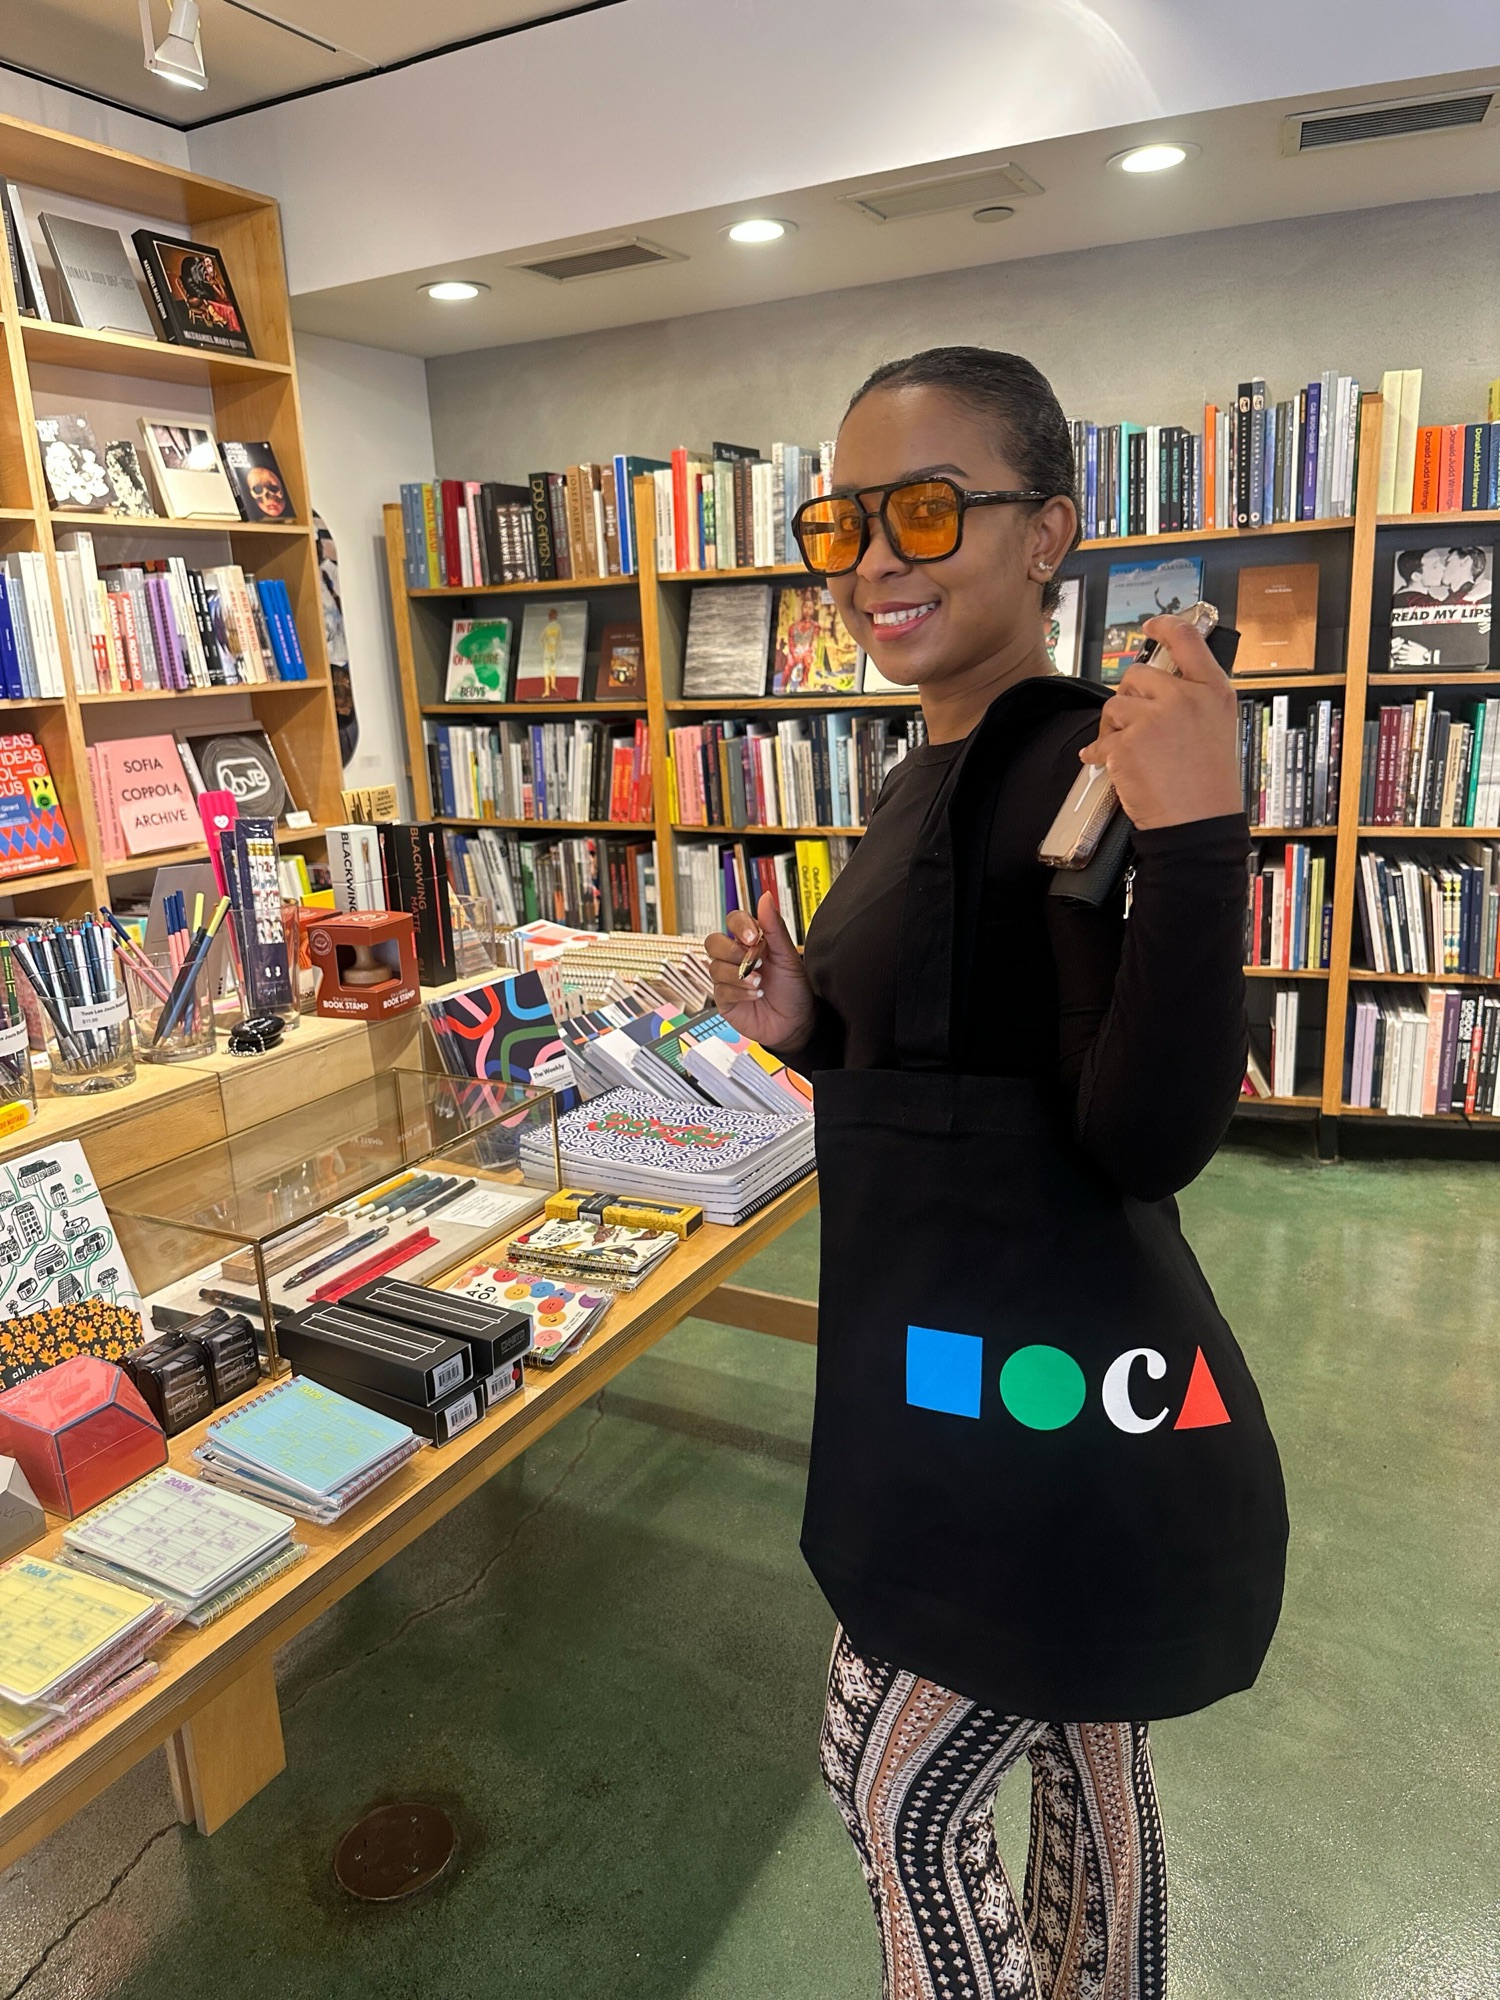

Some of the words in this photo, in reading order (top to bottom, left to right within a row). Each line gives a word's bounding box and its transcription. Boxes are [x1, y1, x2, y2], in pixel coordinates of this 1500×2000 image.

[1424, 431, 1433, 458] Donald
[1448, 430, 1457, 457] Donald
[1474, 428, 1483, 453] Donald
[1423, 459, 1431, 478] Judd
[1473, 453, 1481, 472] Judd
[532, 480, 548, 522] DOUG
[1421, 479, 1430, 511] Writings
[1446, 477, 1454, 510] Writings
[1472, 472, 1480, 508] Interviews
[498, 515, 508, 527] AI
[573, 508, 583, 542] ALBERS
[500, 527, 511, 565] WEIWEI
[109, 598, 122, 639] AMANDA
[1392, 611, 1429, 622] READ
[1433, 609, 1458, 620] MY
[1460, 608, 1493, 619] LIPS
[123, 597, 135, 638] AMANDA
[131, 638, 143, 681] ROSS-HO
[115, 639, 127, 682] ROSS-HO
[123, 758, 163, 774] SOFIA
[121, 782, 183, 802] COPPOLA
[135, 809, 189, 829] ARCHIVE
[340, 832, 358, 913] BLACKWING
[409, 827, 427, 911] BLACKWING
[801, 866, 811, 889] Olafur
[811, 867, 821, 890] Olafur
[410, 896, 422, 934] MATTE
[322, 1000, 345, 1010] BOOK
[345, 1001, 369, 1011] STAMP
[383, 998, 400, 1009] BOOK
[400, 989, 416, 1003] STAMP
[533, 1071, 544, 1079] The
[543, 1063, 565, 1075] Weekly
[12, 1366, 26, 1379] all
[298, 1384, 326, 1400] 2026
[164, 1476, 195, 1492] 2026
[19, 1563, 52, 1579] 2026
